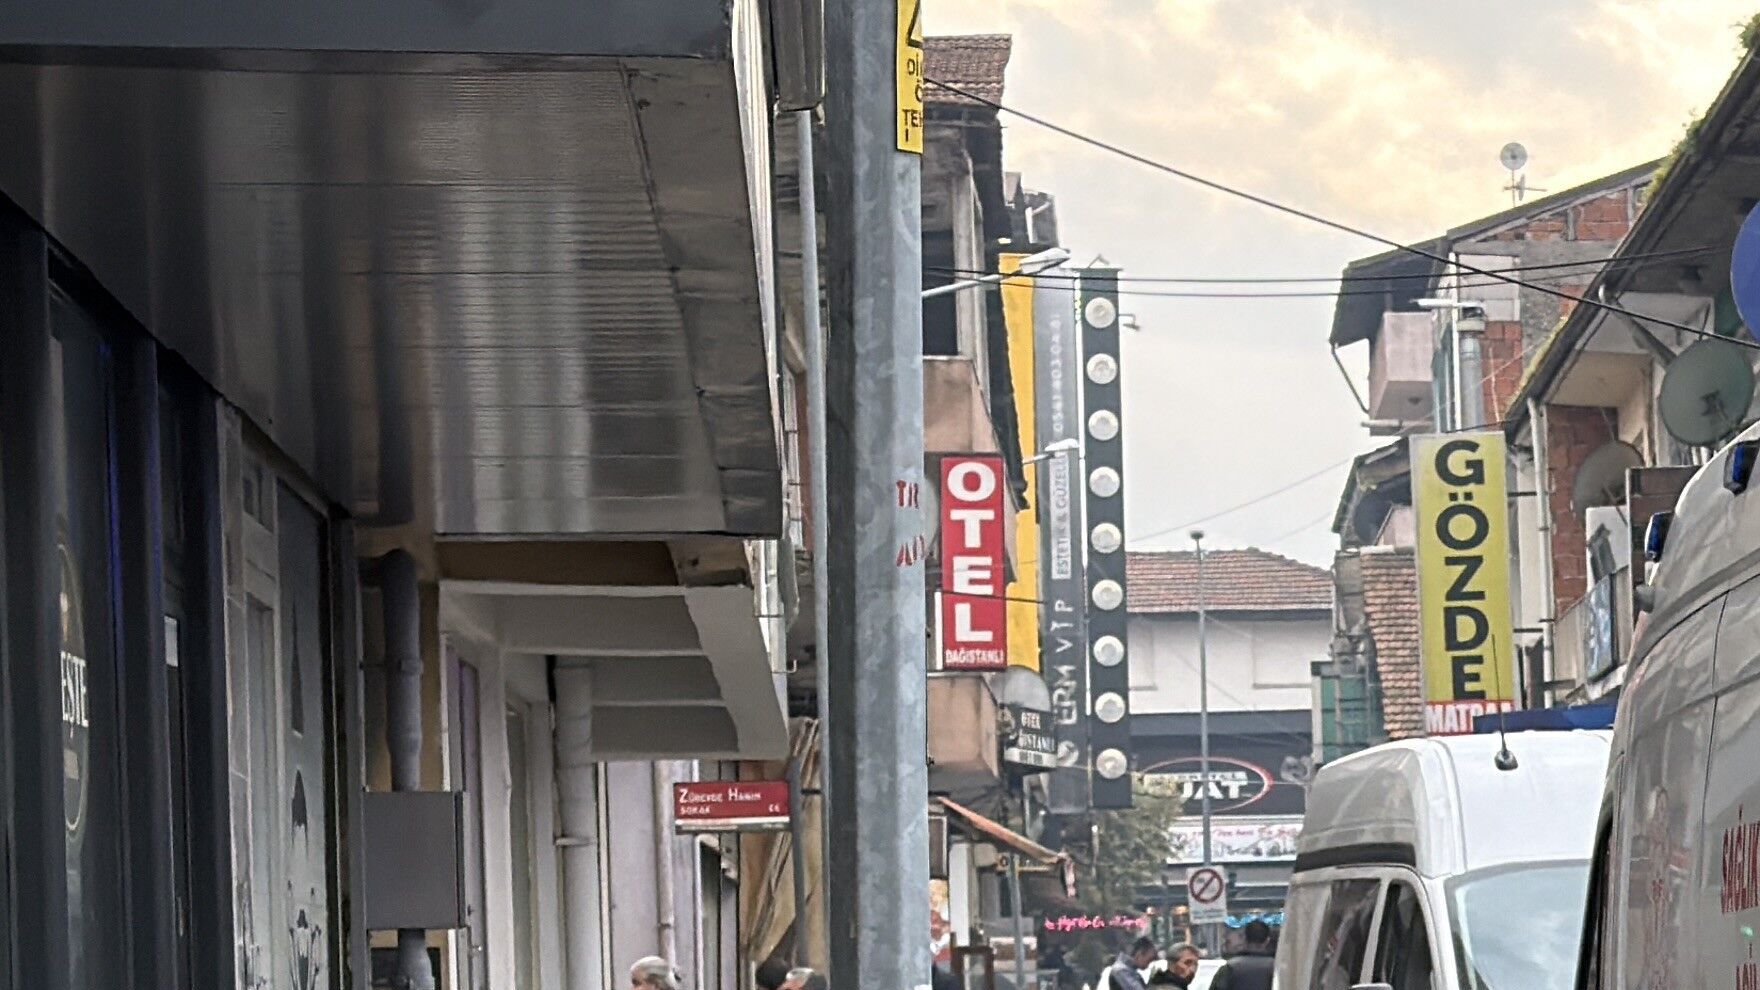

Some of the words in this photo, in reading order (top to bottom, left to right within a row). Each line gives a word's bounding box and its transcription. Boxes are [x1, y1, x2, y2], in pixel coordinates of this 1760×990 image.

[947, 461, 996, 642] OTEL
[1434, 439, 1489, 700] GÖZDE
[1426, 703, 1512, 733] MAT
[1721, 804, 1760, 914] SAĞLIK
